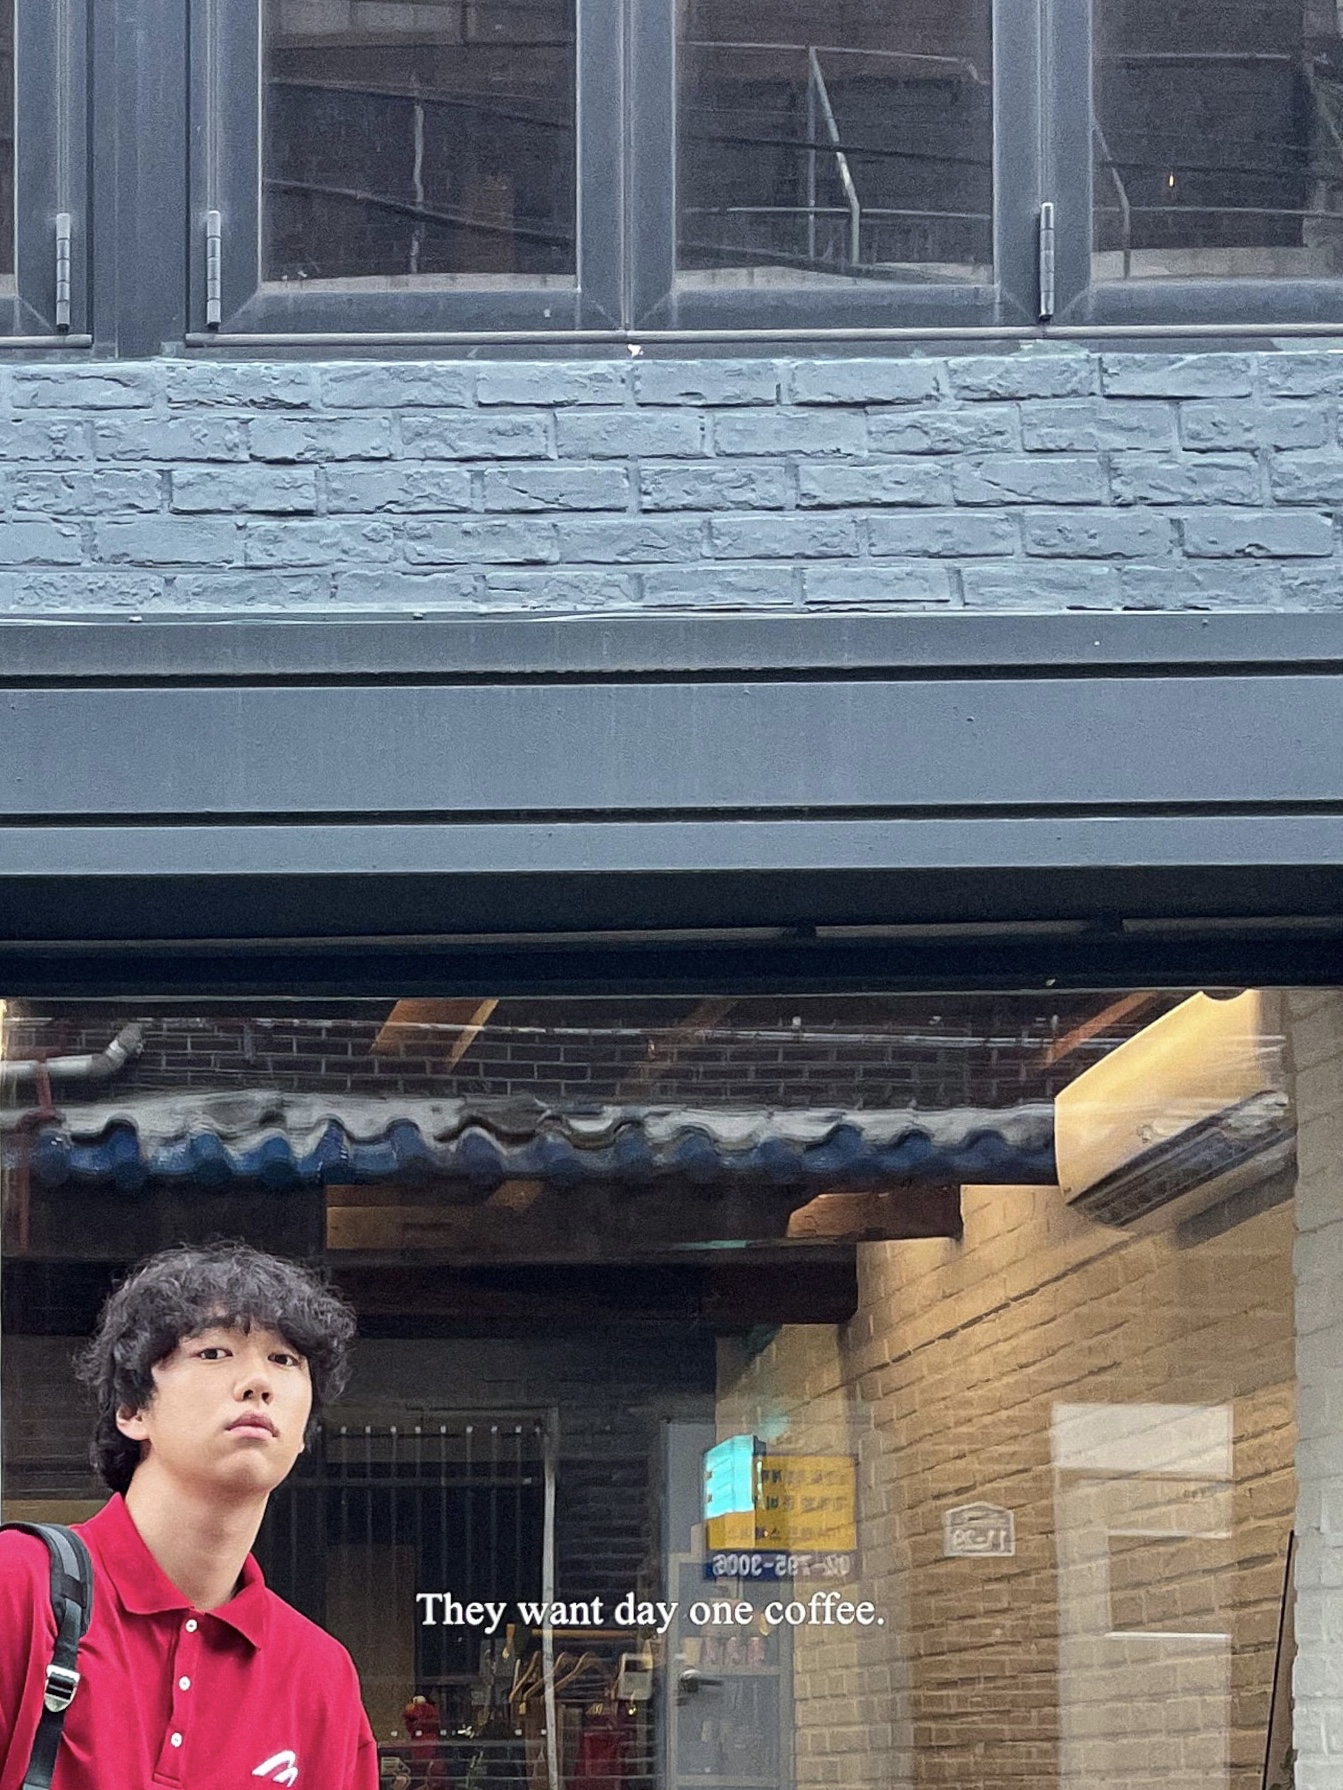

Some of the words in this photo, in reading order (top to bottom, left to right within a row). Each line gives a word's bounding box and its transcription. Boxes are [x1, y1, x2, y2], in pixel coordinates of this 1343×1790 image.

[416, 1592, 506, 1634] They
[517, 1598, 604, 1627] want
[614, 1592, 679, 1634] day
[689, 1601, 754, 1626] one
[764, 1592, 886, 1627] coffee.
